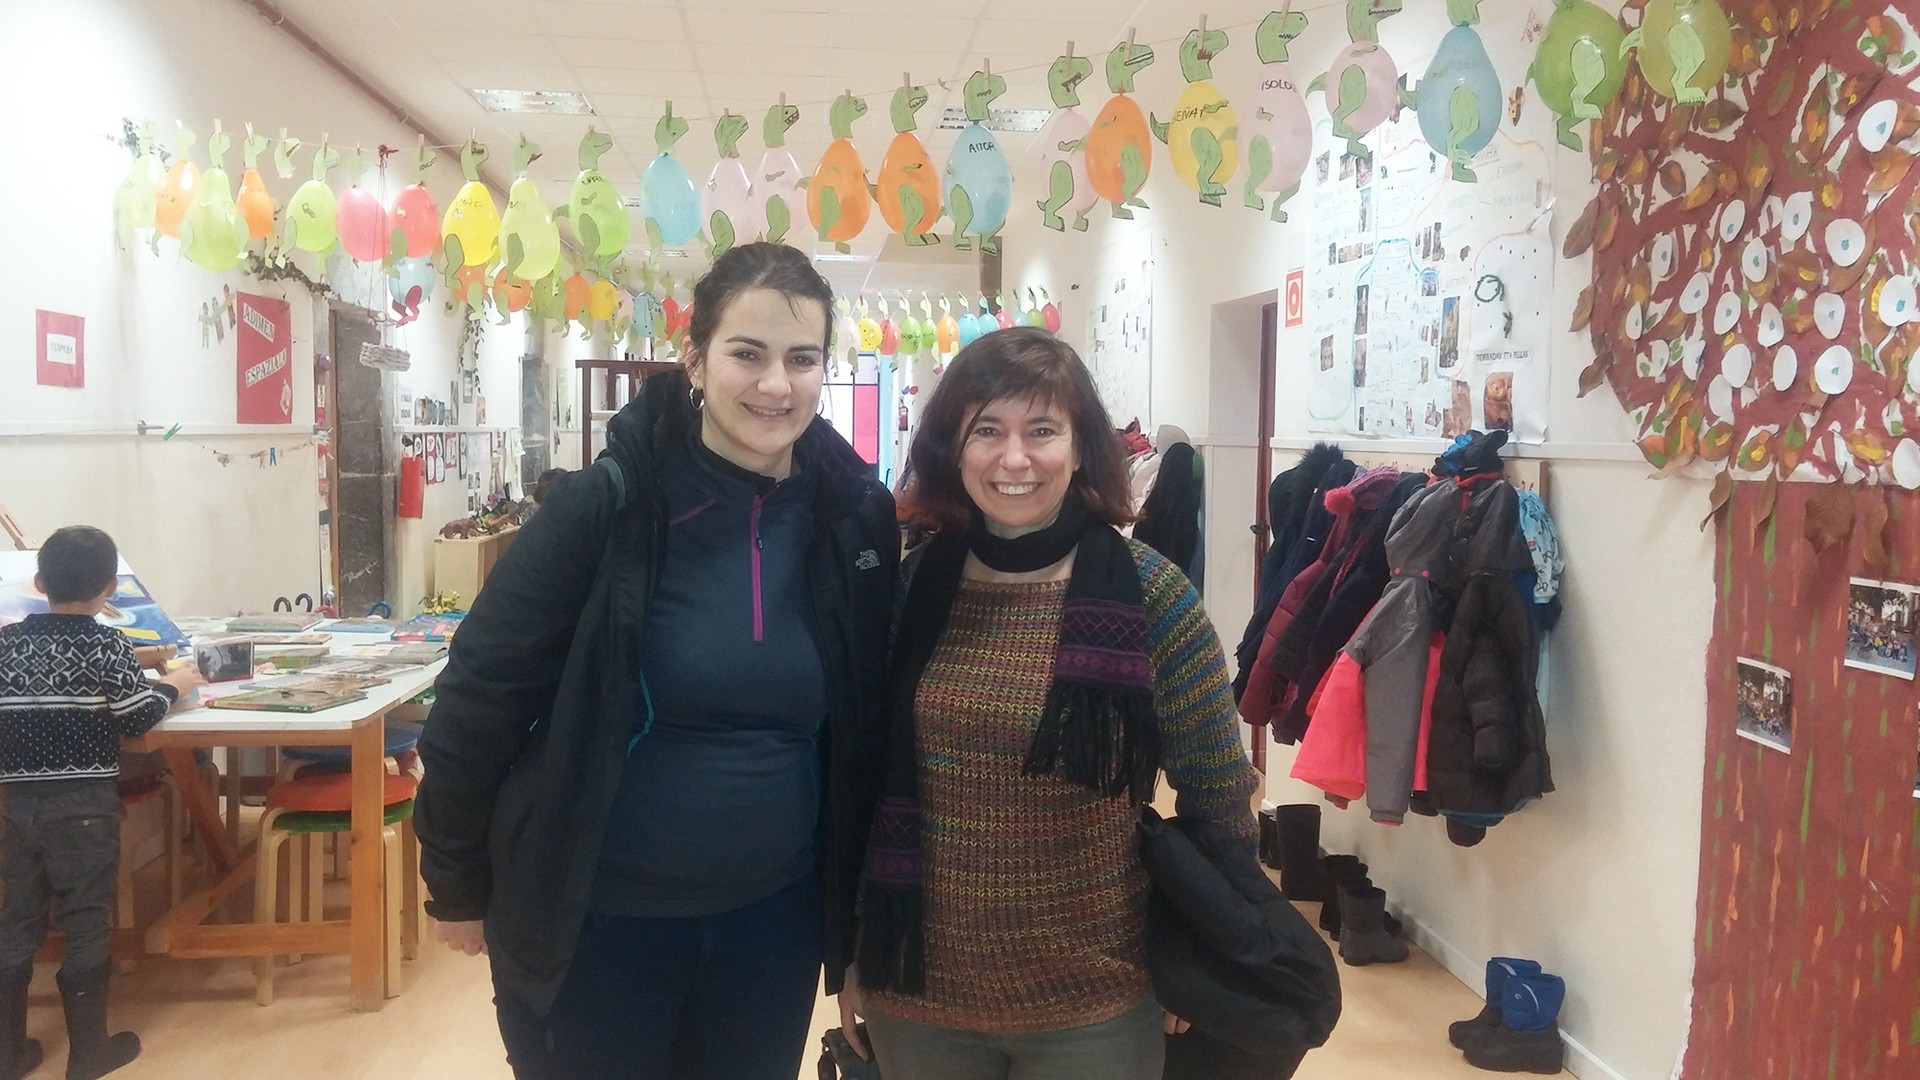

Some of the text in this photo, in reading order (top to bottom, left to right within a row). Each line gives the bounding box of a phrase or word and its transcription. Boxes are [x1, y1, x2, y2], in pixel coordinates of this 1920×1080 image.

[1171, 106, 1205, 125] EÑAT
[968, 141, 998, 153] AITOR
[244, 305, 274, 339] ADIMEN
[247, 350, 286, 385] ESPAZIALA
